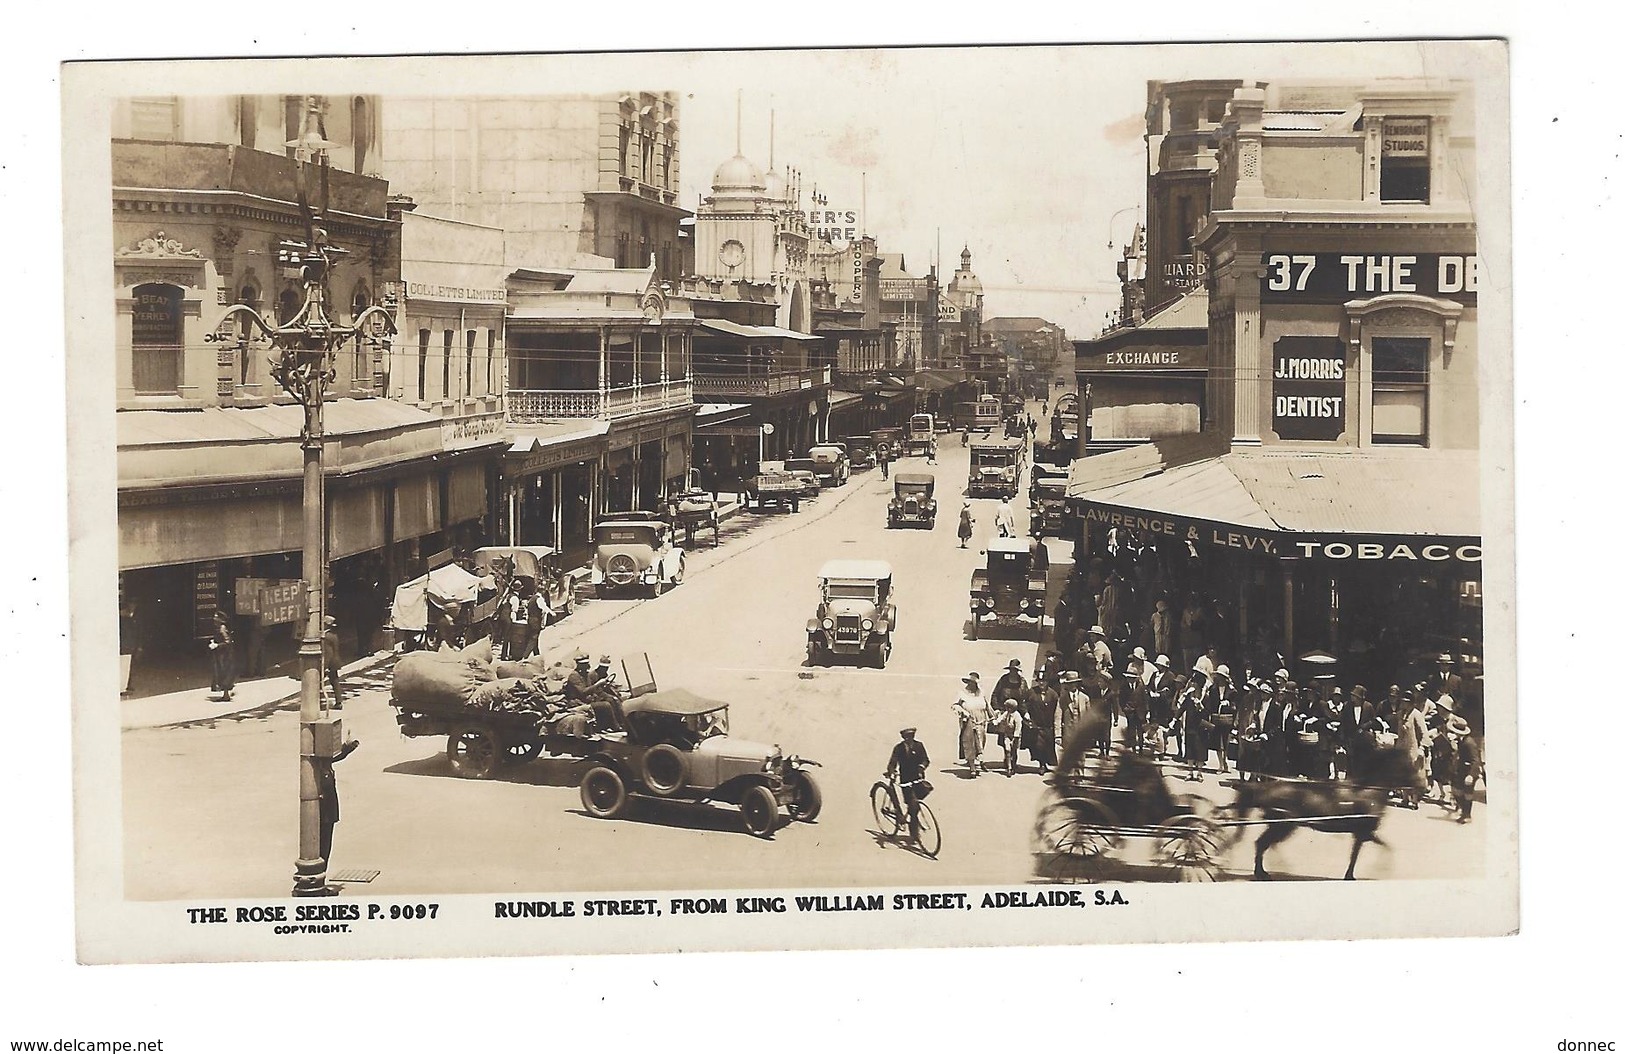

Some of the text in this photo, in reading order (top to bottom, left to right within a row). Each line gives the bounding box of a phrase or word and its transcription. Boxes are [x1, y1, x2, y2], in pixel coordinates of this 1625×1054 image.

[853, 243, 862, 300] HOOPER'S
[1268, 255, 1316, 291] 37
[1340, 255, 1417, 292] THE
[410, 282, 505, 301] COLLETTS LIMITED
[1106, 352, 1179, 365] EXCHANGE
[1275, 358, 1344, 379] J.MORRIS
[1276, 396, 1342, 418] DENTIST
[1076, 506, 1175, 535] LAWRENCE
[1187, 526, 1200, 540] &
[264, 584, 300, 605] KEEP
[264, 611, 273, 620] TO
[273, 604, 302, 622] LEFT
